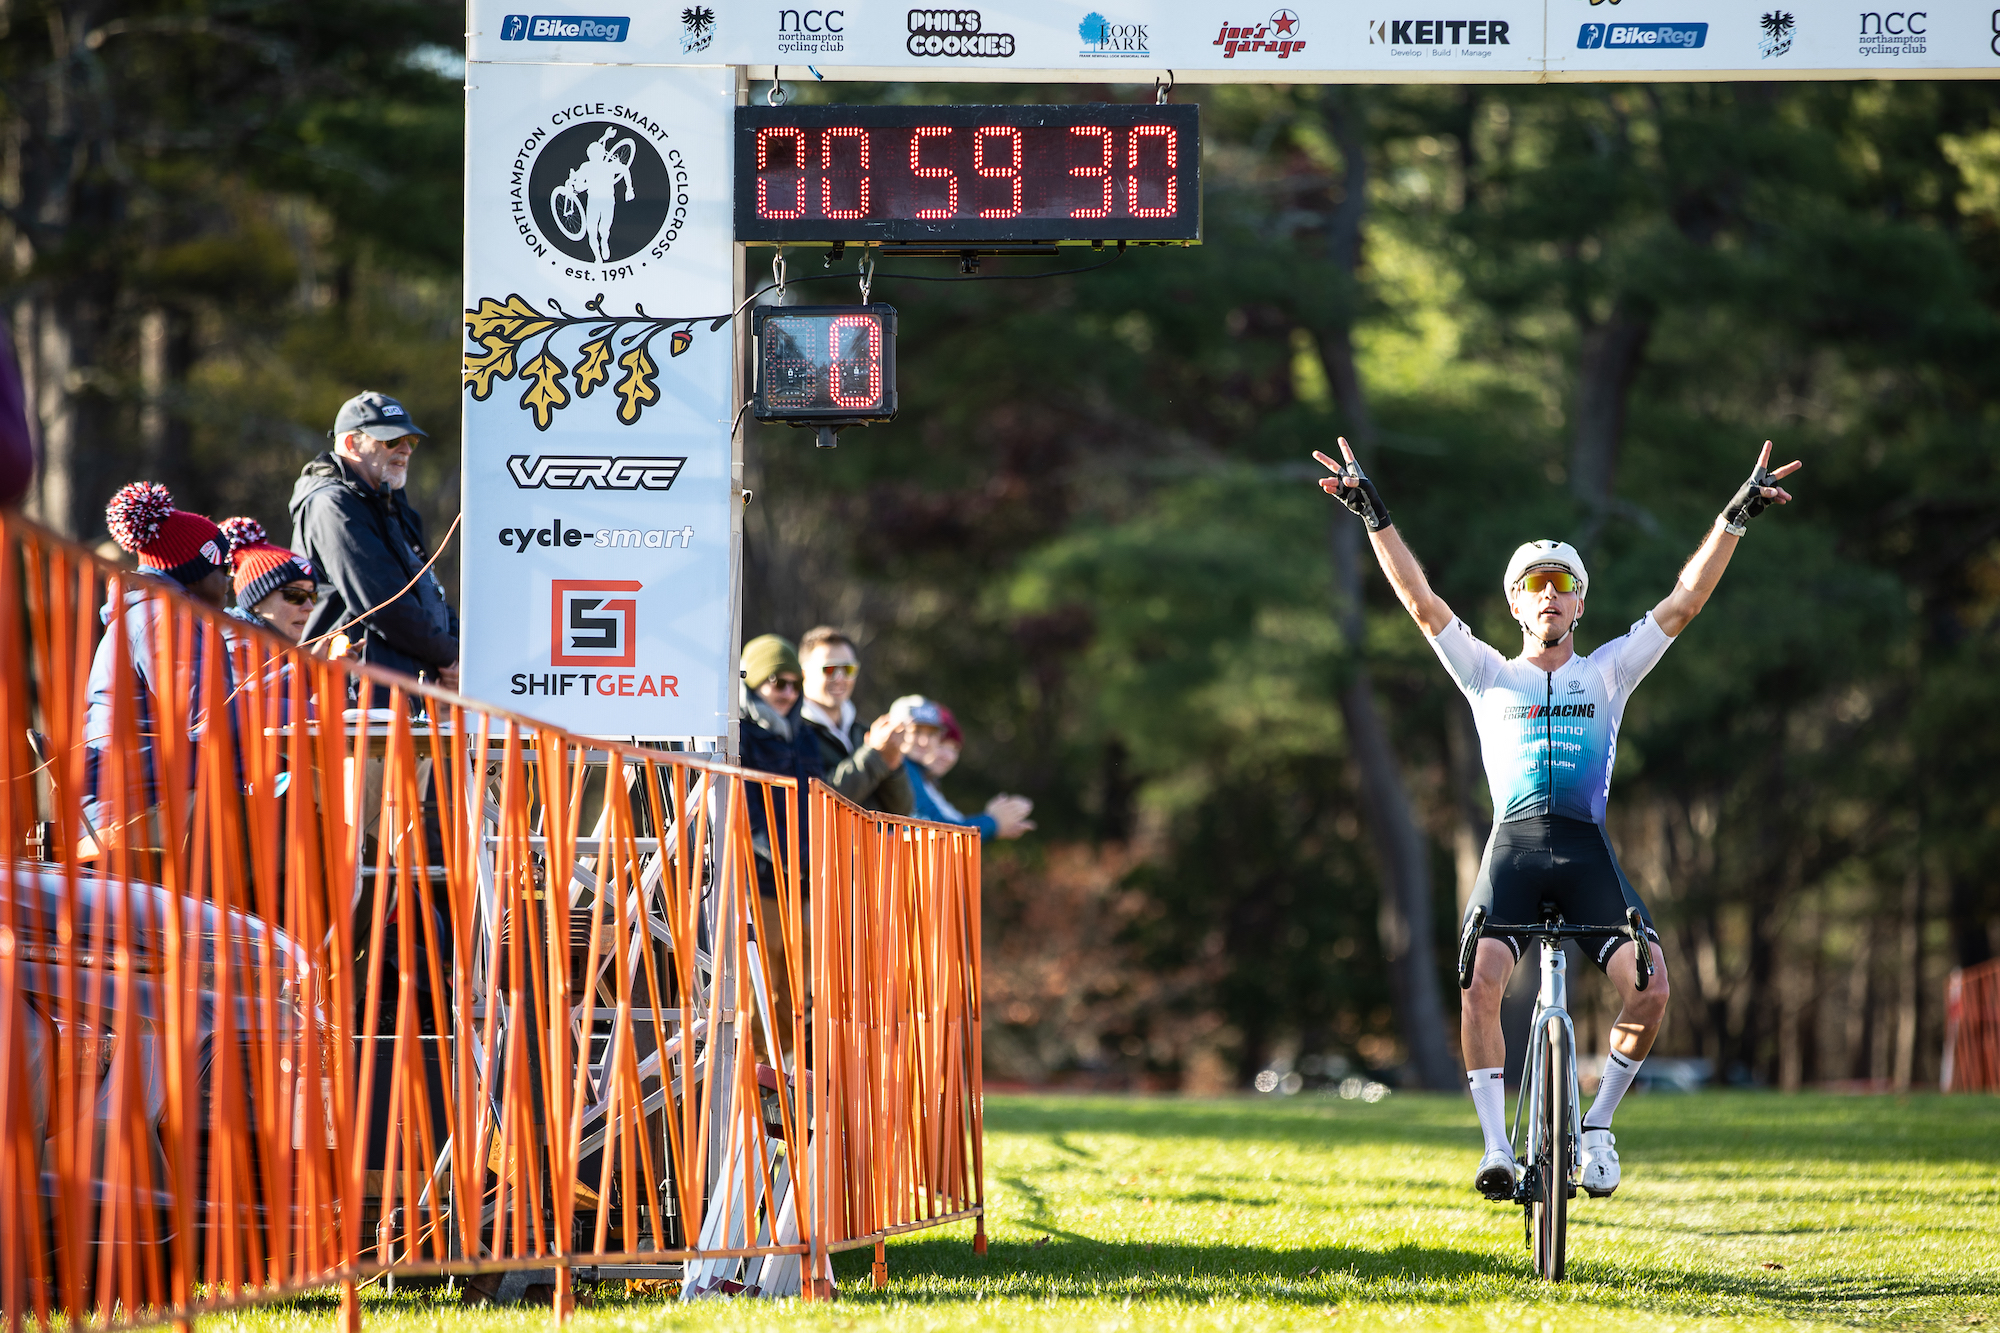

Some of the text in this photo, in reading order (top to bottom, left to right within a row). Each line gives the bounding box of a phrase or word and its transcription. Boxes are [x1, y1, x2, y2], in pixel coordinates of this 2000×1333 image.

[533, 19, 620, 41] BikeReg
[779, 9, 844, 33] ncc
[908, 9, 981, 33] PHIL'S
[1100, 24, 1149, 38] LOOK
[1859, 12, 1927, 34] ncc
[778, 32, 844, 43] northampton
[1100, 37, 1149, 50] PARK
[1212, 21, 1270, 45] joe's
[1391, 20, 1511, 45] KEITER
[1610, 27, 1698, 47] BikeReg
[1858, 35, 1926, 45] northampton
[778, 42, 844, 54] cycling club
[907, 33, 1015, 57] COOKIES
[1224, 40, 1306, 59] garage
[1391, 49, 1422, 57] Develop
[1461, 49, 1492, 58] Manage
[1858, 44, 1927, 56] cycling club
[510, 102, 689, 260] NORTHAMPTON CYCLE-SMART CYCLOCROSS
[756, 126, 1178, 219] 00 59 30
[565, 265, 634, 282] est. 1991
[829, 315, 880, 408] 0
[506, 455, 688, 491] VERGE
[498, 519, 695, 554] cycle-smart
[510, 673, 680, 698] SHIFTGEAR
[1538, 703, 1595, 719] RACING
[1518, 725, 1584, 736] HIMANO
[1602, 714, 1620, 801] TREK
